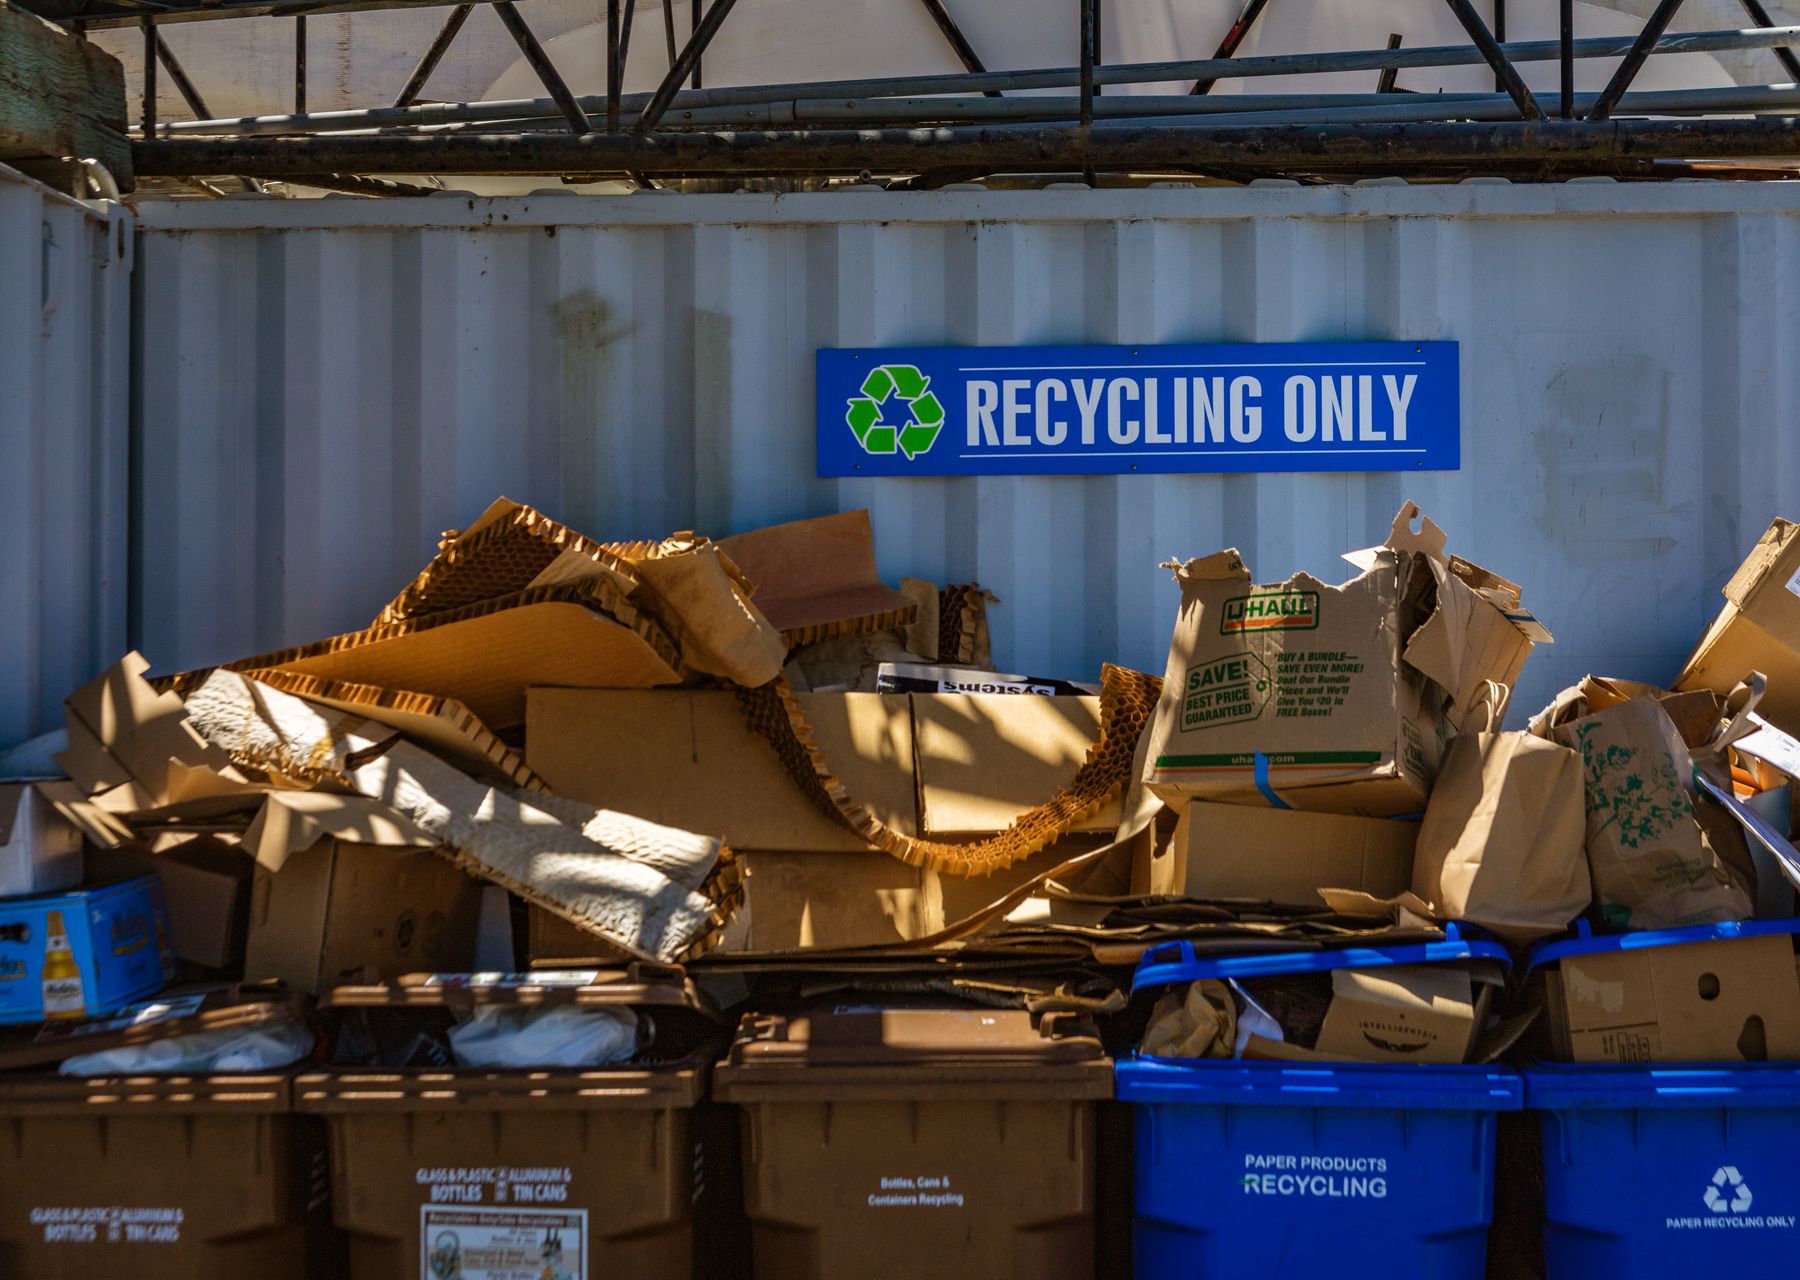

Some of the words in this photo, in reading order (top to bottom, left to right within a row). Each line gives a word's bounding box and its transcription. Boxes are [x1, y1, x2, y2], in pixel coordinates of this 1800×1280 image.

[966, 375, 1262, 446] RECYCLING
[1283, 375, 1418, 442] ONLY
[1227, 596, 1313, 620] U-HAUL
[1298, 652, 1305, 662] A
[1188, 660, 1249, 690] SAVE!
[1277, 663, 1302, 674] SAVE
[1303, 663, 1329, 674] EVEN
[1330, 663, 1364, 674] MORE!
[1299, 674, 1315, 684] Our
[1317, 674, 1350, 684] Bundle
[1277, 686, 1304, 696] Prices
[1306, 686, 1325, 695] and
[1186, 694, 1213, 712] BEST
[1215, 687, 1250, 706] PRICE
[1277, 697, 1296, 707] Give
[1298, 697, 1314, 706] You
[1334, 696, 1344, 705] in
[1277, 707, 1300, 718] FREE
[1300, 707, 1333, 717] Boxes!
[1244, 1153, 1297, 1170] PAPER
[1300, 1155, 1388, 1173] PRODUCTS
[415, 1167, 448, 1184] GLASS
[457, 1167, 495, 1184] PLASTIC
[917, 1175, 941, 1189] Cans
[942, 1175, 950, 1188] &
[430, 1183, 483, 1202] BOTTLES
[512, 1184, 533, 1201] TIN
[534, 1183, 569, 1202] CANS
[1243, 1173, 1388, 1198] RECYCLING
[867, 1193, 918, 1207] Containers
[918, 1192, 964, 1208] Recycling
[1666, 1216, 1702, 1230] PAPER
[1703, 1216, 1764, 1229] RECYCLING
[1766, 1215, 1796, 1229] ONLY
